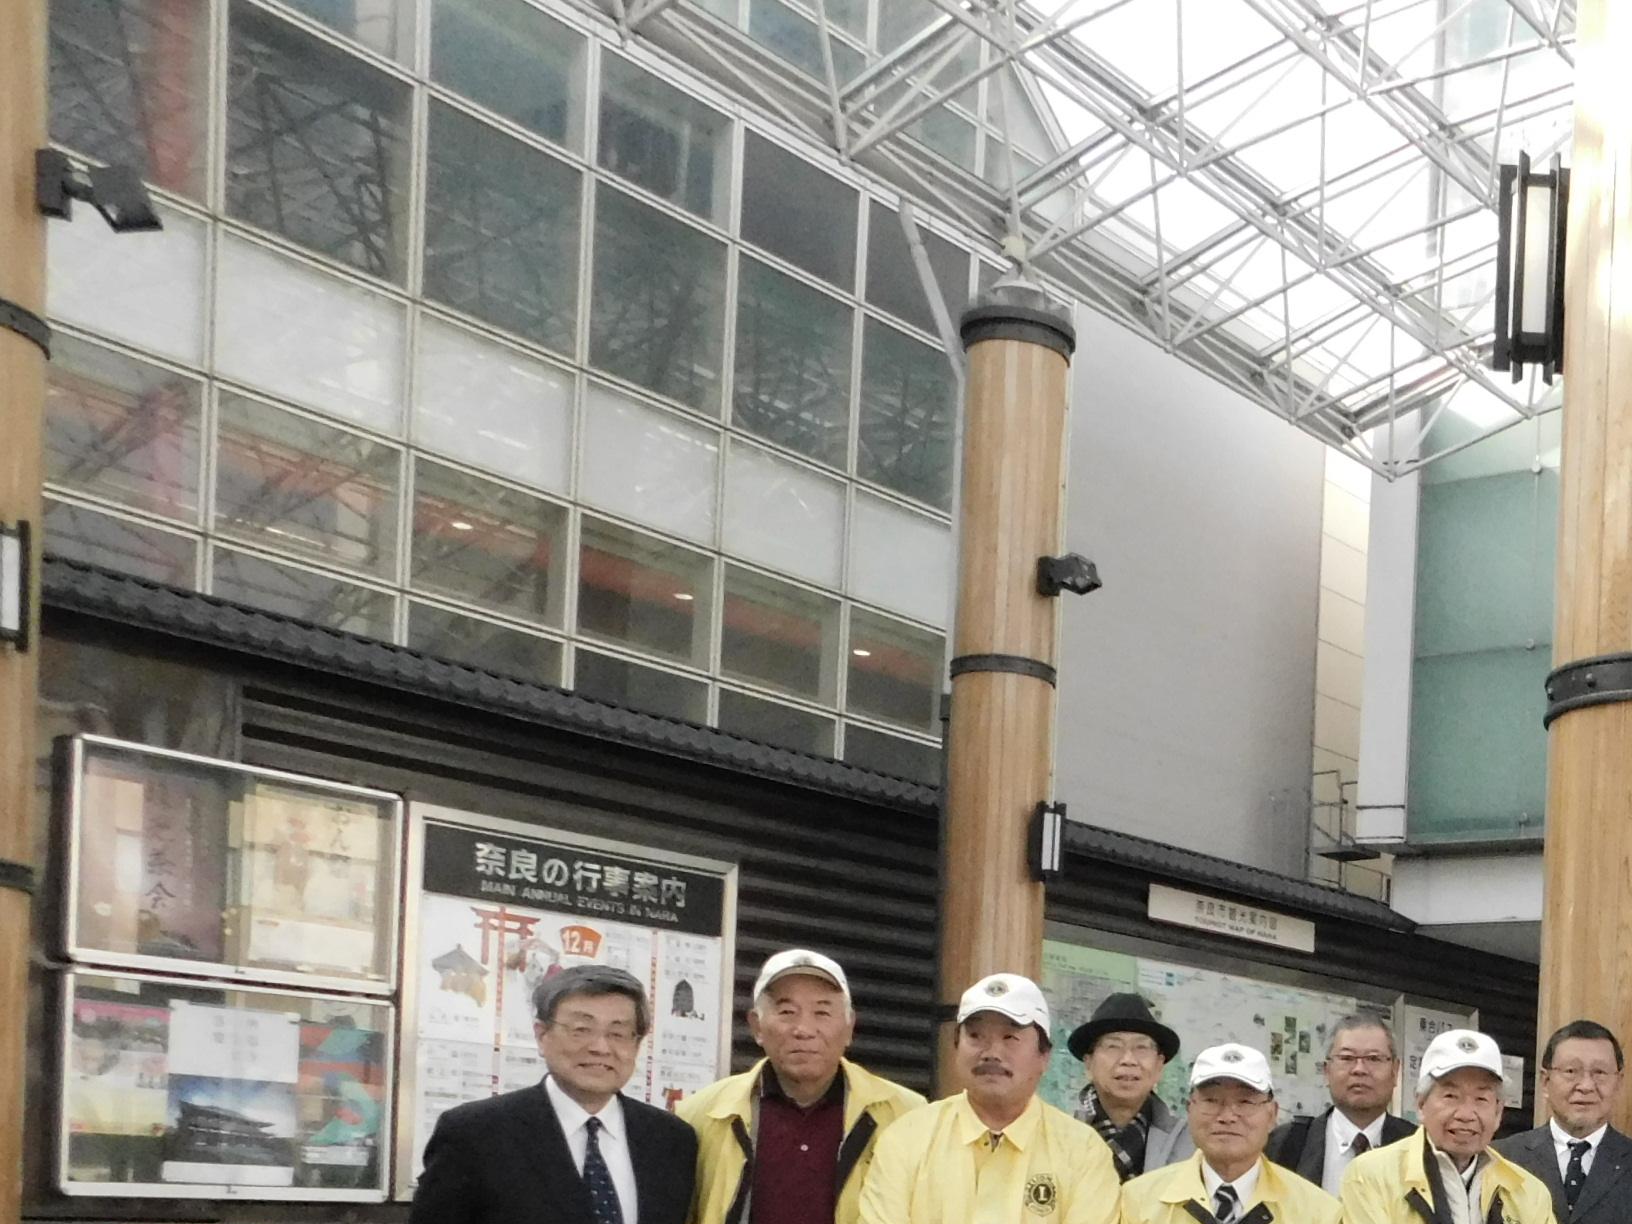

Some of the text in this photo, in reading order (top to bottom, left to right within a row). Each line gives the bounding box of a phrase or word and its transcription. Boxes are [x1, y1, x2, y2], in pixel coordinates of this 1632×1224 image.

[475, 841, 687, 908] 奈良の行事案内
